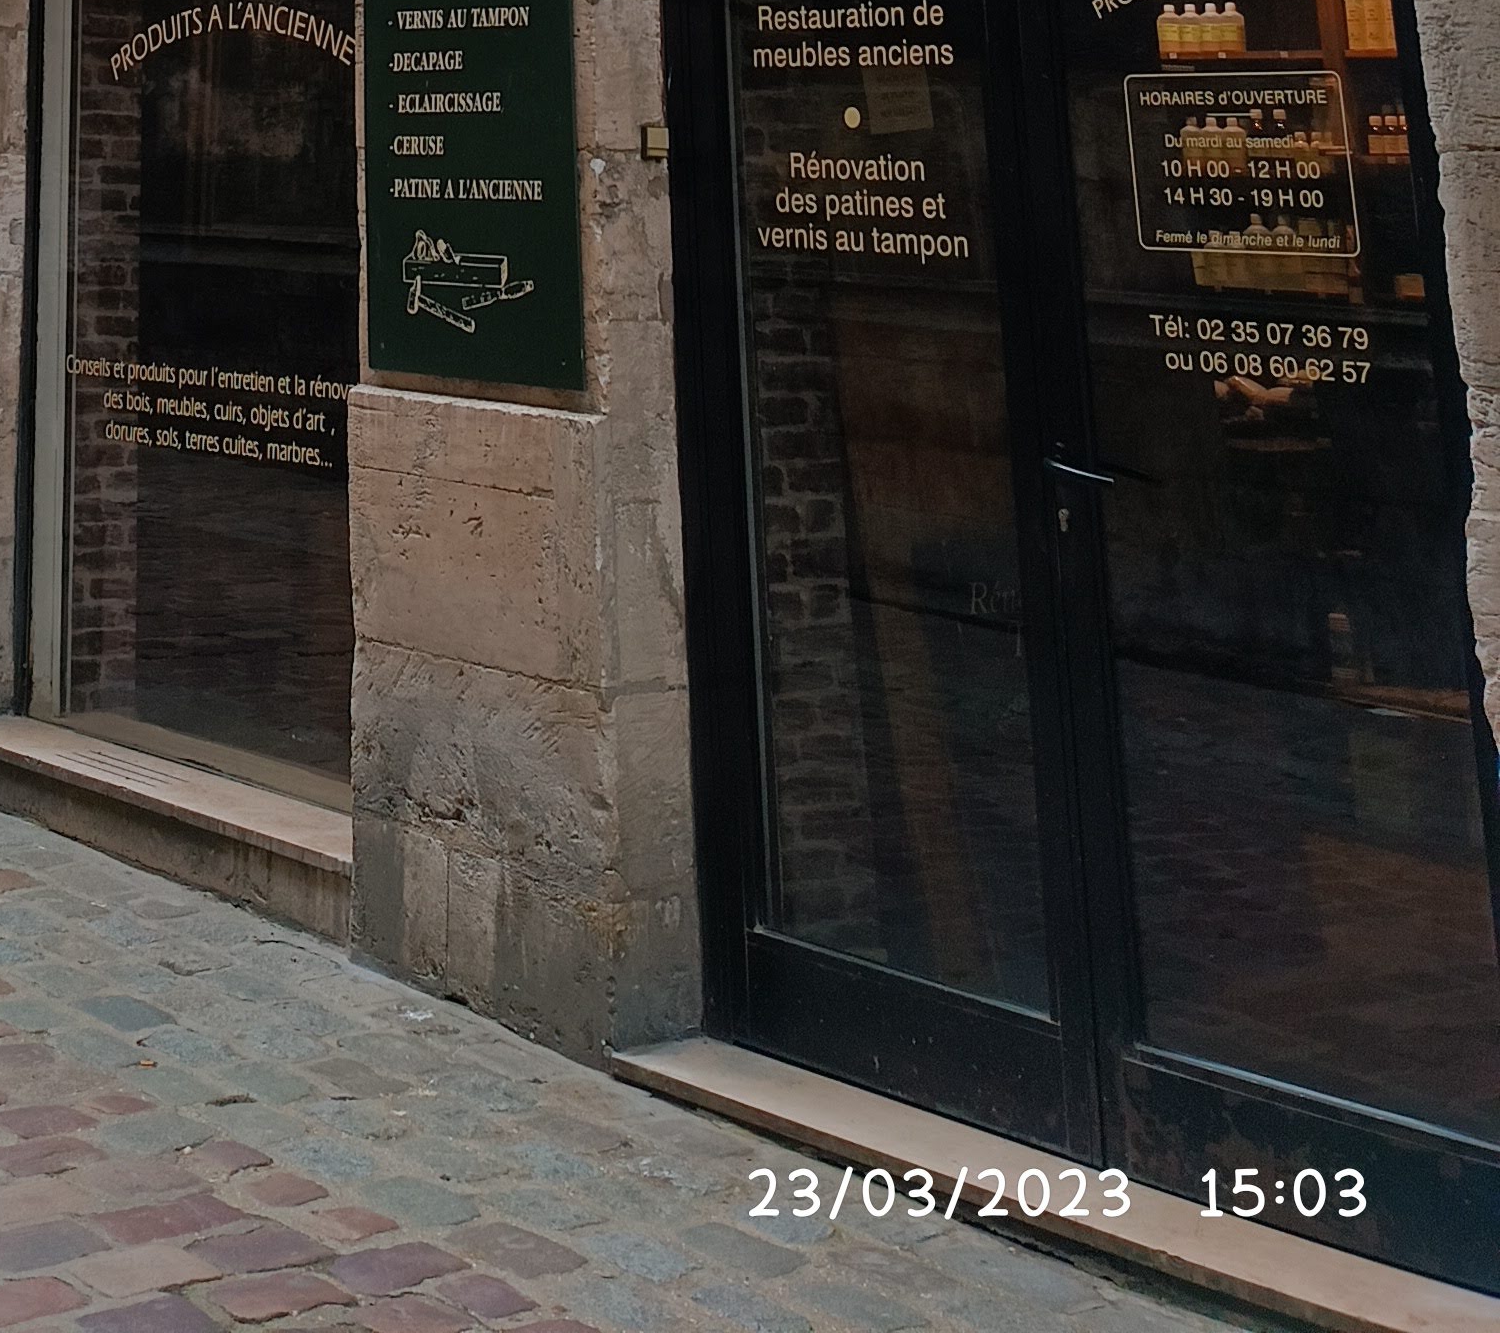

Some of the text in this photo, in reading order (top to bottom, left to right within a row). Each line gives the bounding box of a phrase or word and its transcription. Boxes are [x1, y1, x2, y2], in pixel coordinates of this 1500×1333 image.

[397, 9, 444, 30] VERNIS
[447, 9, 467, 29] AU
[471, 6, 530, 28] TAMPON
[757, 0, 944, 31] Restauration de
[110, 1, 356, 81] PRODUITS A L'ANCIENNE
[753, 38, 954, 68] meubles anciens
[398, 92, 501, 114] ECLAIRCISSAGE
[1139, 89, 1328, 106] HORAIRES d'OUVERTURE
[1164, 133, 1294, 149] Du mardi au samedi
[789, 150, 926, 181] Rénovation
[1161, 160, 1182, 178] 10
[1187, 160, 1201, 178] H
[1206, 160, 1230, 178] 00
[1247, 161, 1270, 178] 12
[1275, 162, 1291, 179] H
[1296, 161, 1321, 180] 00
[444, 179, 455, 199] A
[458, 179, 543, 200] L'ANCIENNE
[776, 187, 946, 221] des patines et
[1164, 187, 1185, 205] 14
[1190, 188, 1204, 205] H
[1209, 188, 1233, 206] 30
[1250, 188, 1273, 206] 19
[1279, 189, 1294, 207] H
[1300, 190, 1324, 208] 00
[758, 223, 969, 264] vernis au tampon
[1155, 230, 1341, 249] Fermé le dimanche et le lundi
[1149, 314, 1369, 350] Tél: 02 35 07 36 79
[66, 354, 110, 378] Conseils
[113, 358, 125, 378] et
[127, 361, 176, 385] produits
[178, 366, 208, 389] pour
[211, 366, 274, 393] l'entretien
[278, 374, 291, 396] et
[294, 374, 306, 397] la
[1165, 351, 1371, 384] ou 06 08 60 62 57
[103, 389, 124, 409] des
[126, 389, 153, 416] bois,
[156, 396, 210, 422] meubles,
[214, 401, 246, 426] cuirs,
[250, 403, 290, 432] objets
[105, 419, 333, 468] dorures, sols, terres cuites, marbres...
